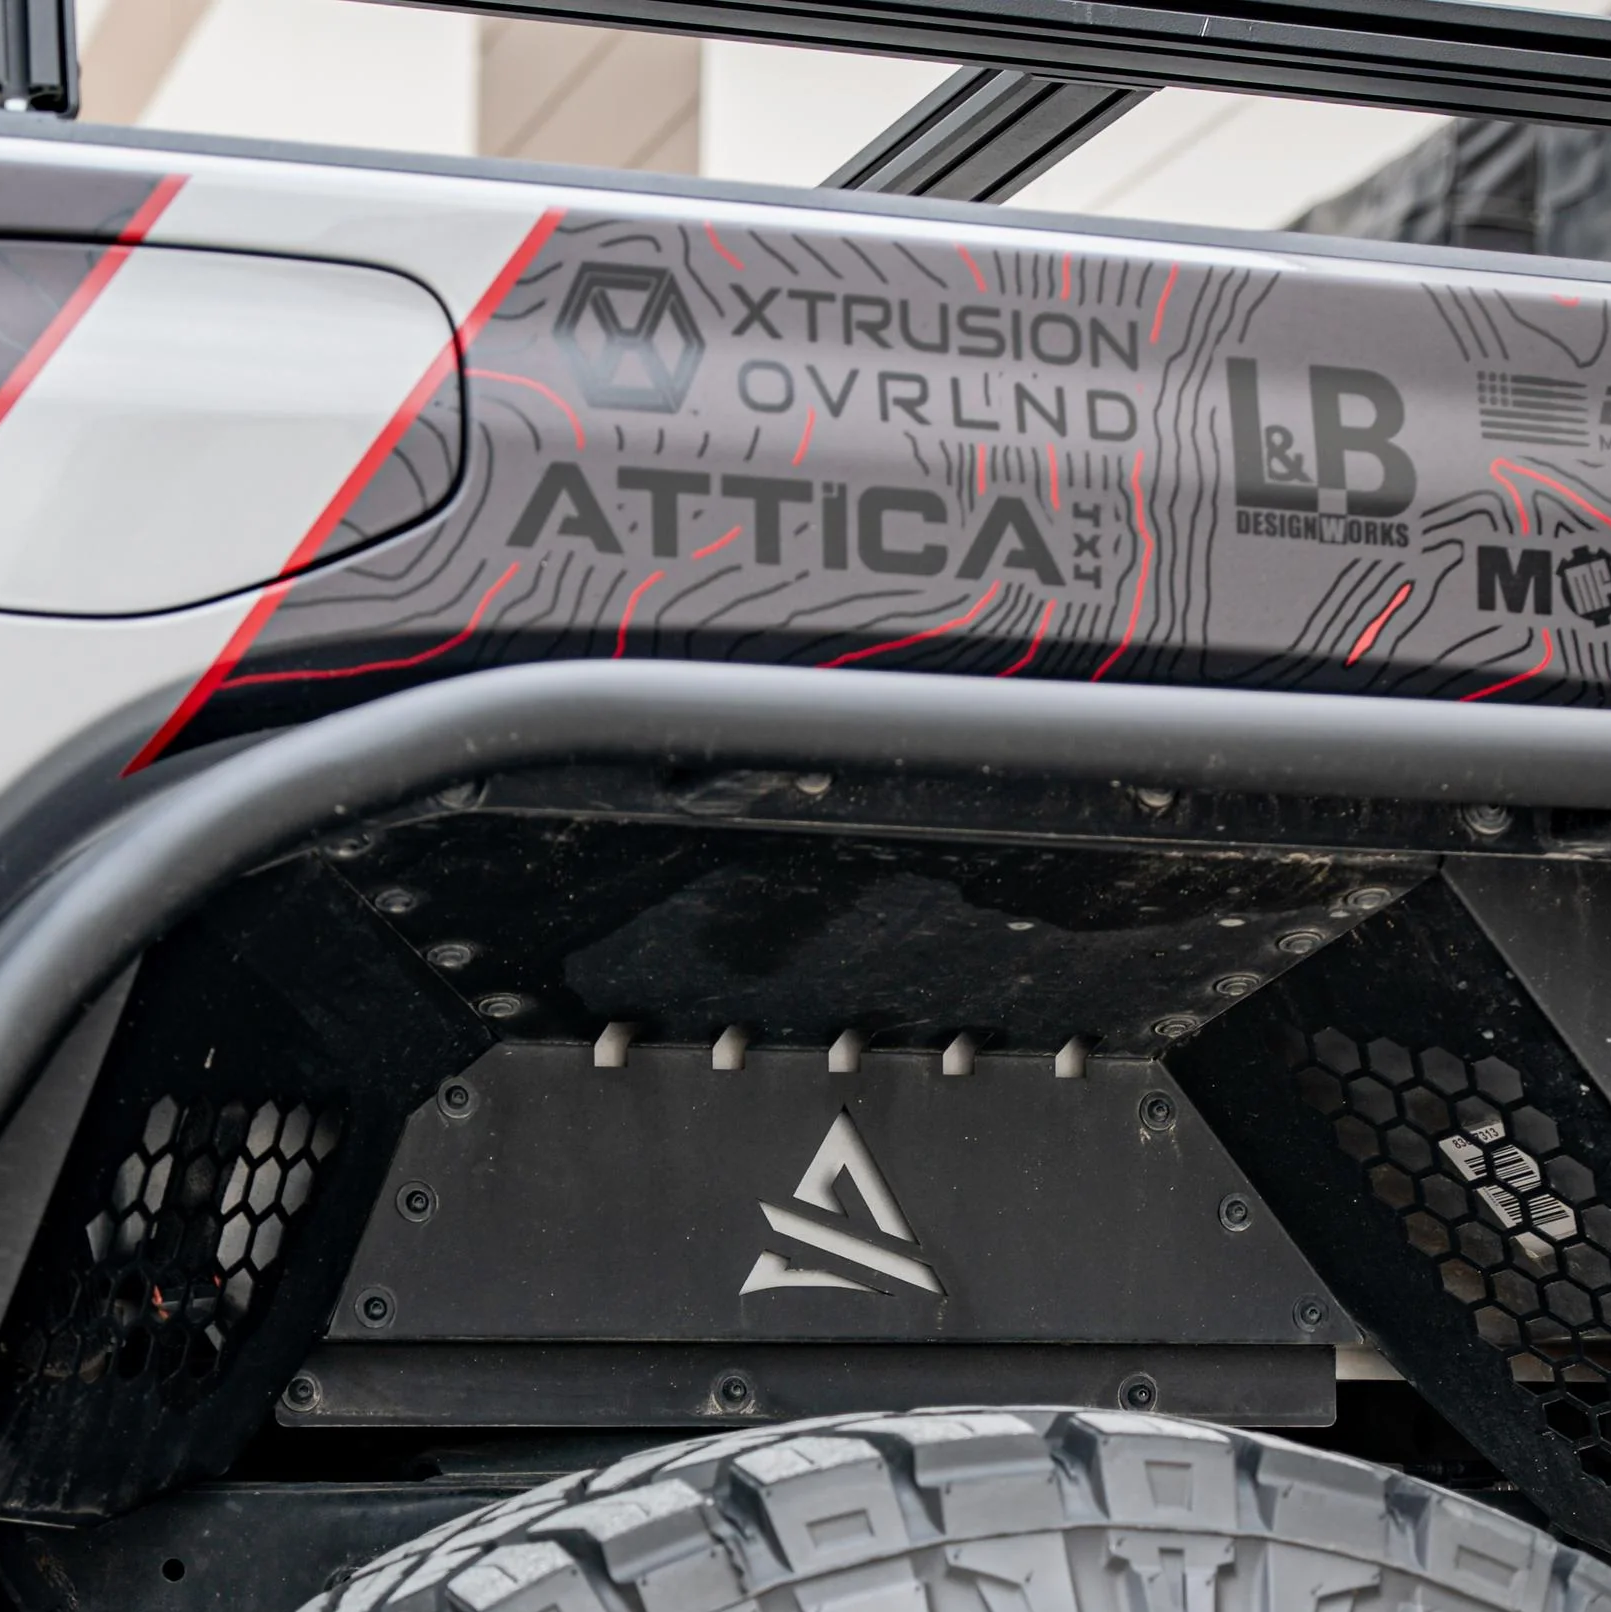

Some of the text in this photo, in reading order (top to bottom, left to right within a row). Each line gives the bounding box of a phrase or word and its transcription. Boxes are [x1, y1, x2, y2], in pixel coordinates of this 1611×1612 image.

[730, 283, 1139, 372] XTRUSION
[737, 359, 1138, 442] OVRLND
[1225, 356, 1418, 518] L&B
[1236, 509, 1410, 548] DESIGNWORKS
